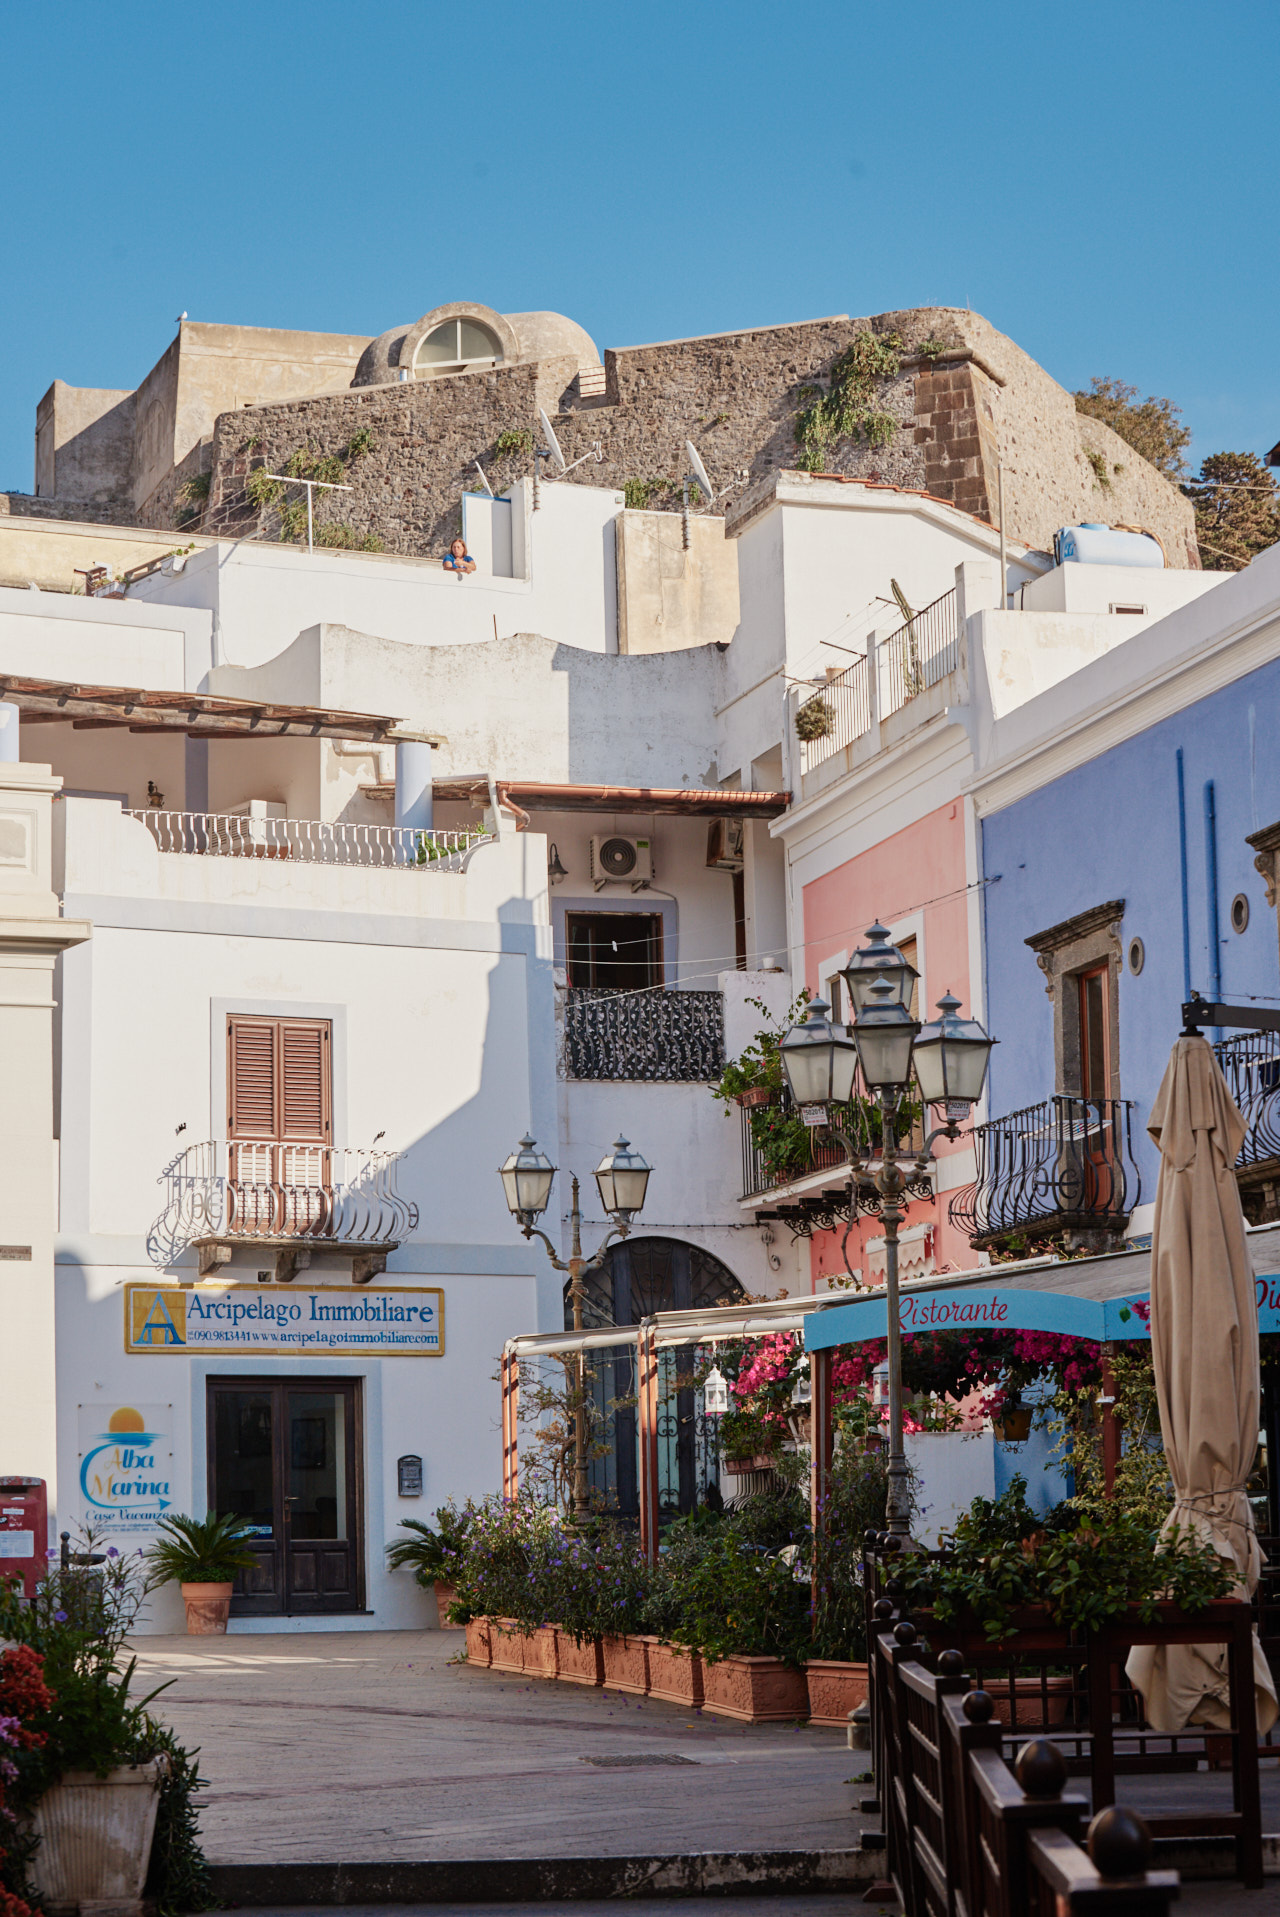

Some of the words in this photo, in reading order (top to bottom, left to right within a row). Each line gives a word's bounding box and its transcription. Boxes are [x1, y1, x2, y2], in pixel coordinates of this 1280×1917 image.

[187, 1294, 302, 1327] Arcipelago
[309, 1296, 434, 1323] Immobiliare
[899, 1296, 1008, 1331] Ristorante
[104, 1447, 155, 1474] Alba
[90, 1473, 170, 1502] Marina
[86, 1509, 116, 1520] Case
[120, 1509, 169, 1520] Vacanze
